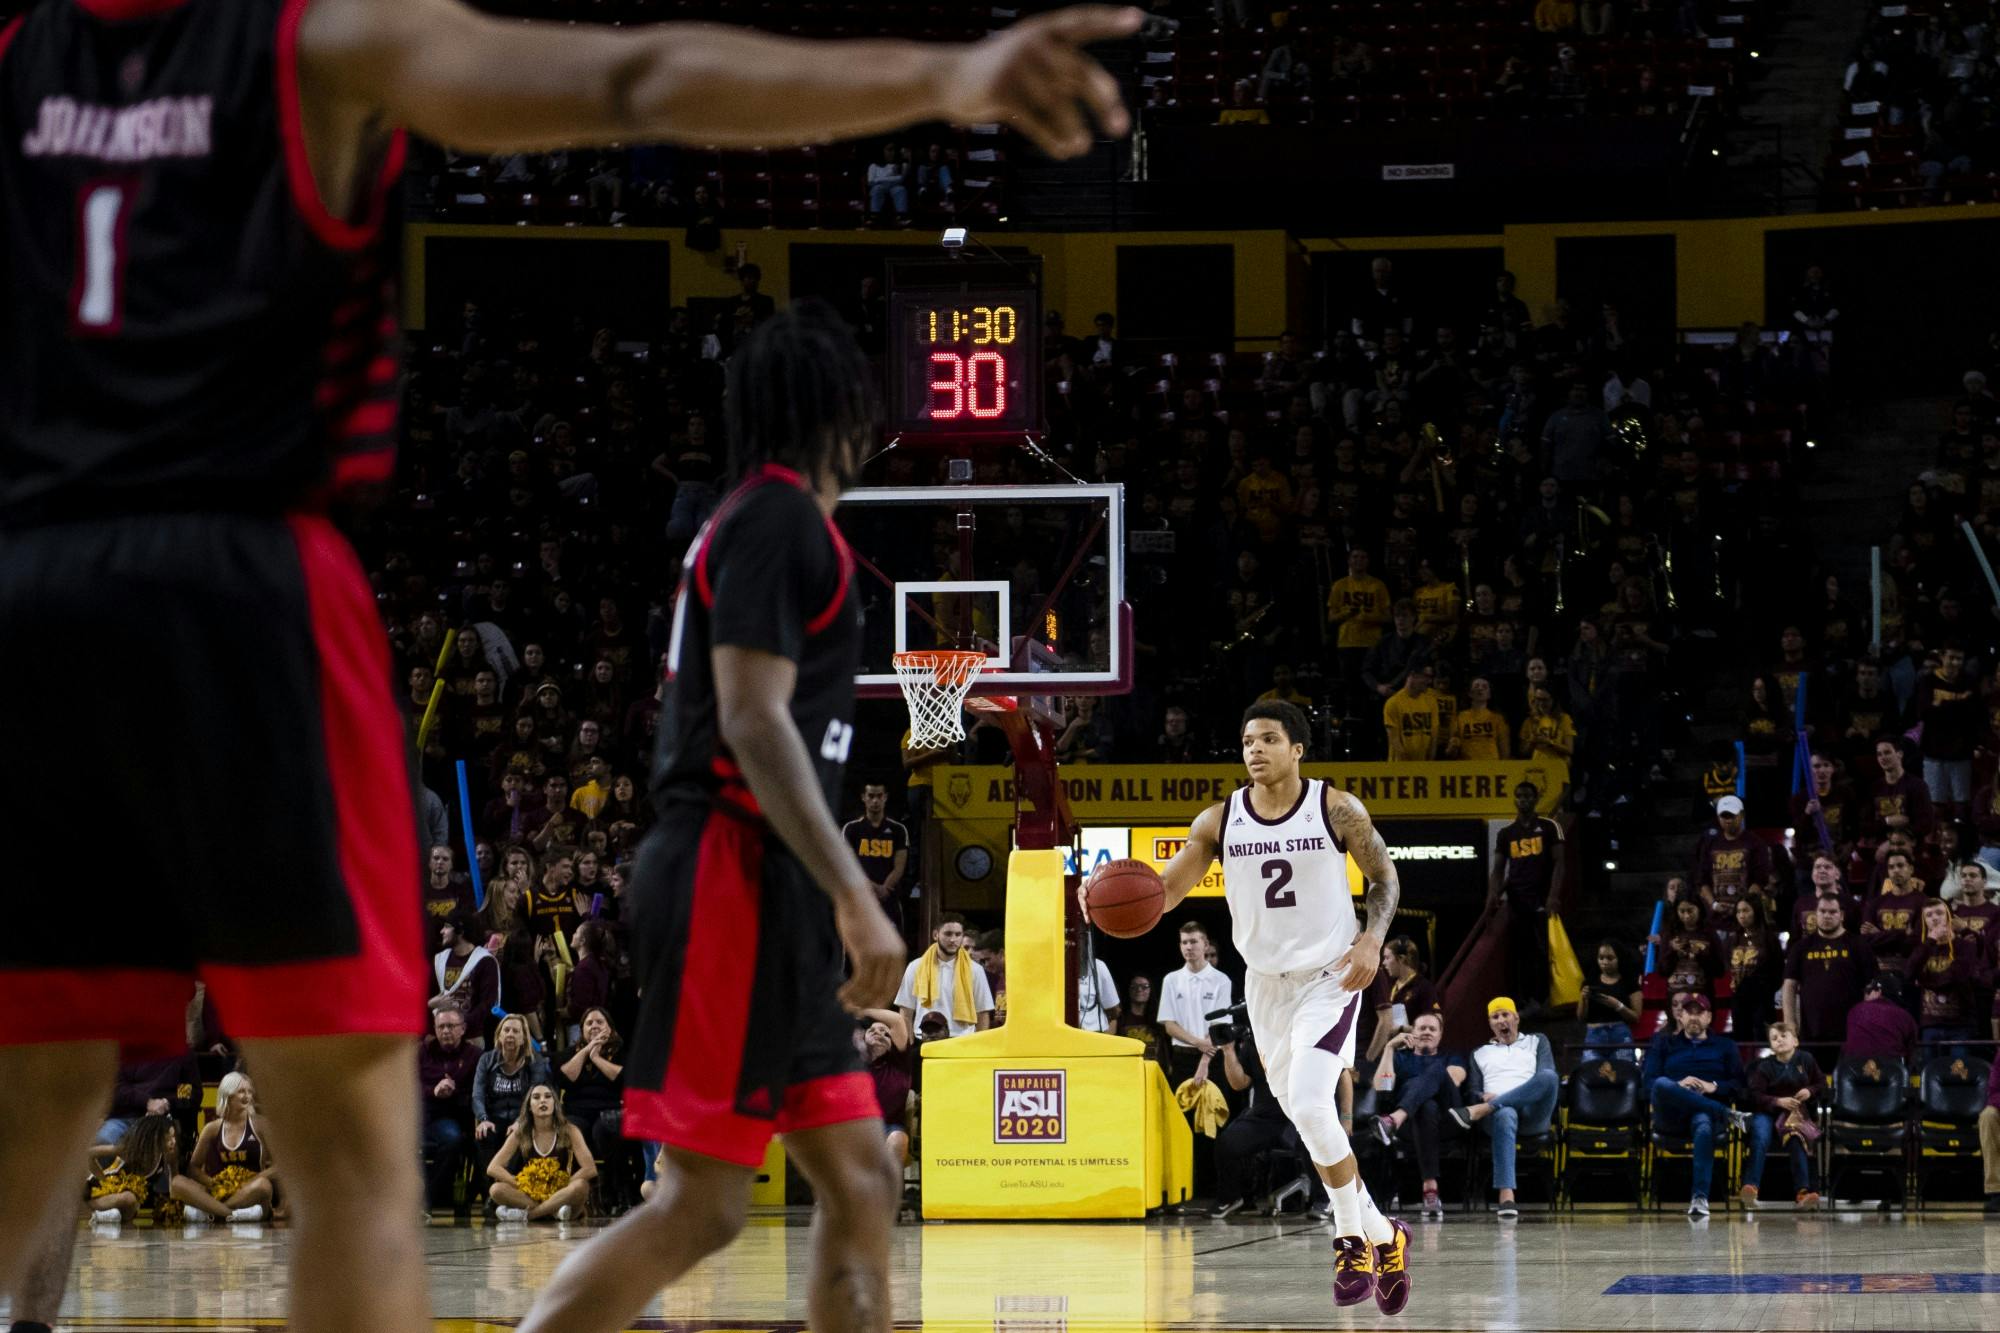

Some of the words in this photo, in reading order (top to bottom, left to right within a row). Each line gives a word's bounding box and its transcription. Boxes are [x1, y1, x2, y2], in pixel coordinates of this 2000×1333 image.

[23, 96, 211, 162] JOHNSON
[78, 184, 123, 326] 1
[930, 307, 1016, 343] 11:30
[930, 352, 1005, 418] 30
[1343, 591, 1376, 606] ASU
[1403, 712, 1431, 730] ASU
[1463, 722, 1493, 737] ASU
[987, 779, 1102, 801] ABON
[1111, 779, 1152, 801] ALL
[1162, 778, 1224, 801] HOPE
[1345, 776, 1429, 799] ENTER
[1439, 775, 1507, 798] HERE
[859, 838, 893, 857] ASU
[1229, 841, 1281, 857] ARIZONA
[1286, 837, 1325, 852] STATE
[1386, 846, 1475, 860] OWERADE
[1510, 836, 1542, 857] ASU
[1261, 859, 1296, 908] 2
[1003, 1078, 1058, 1089] CAMPAIGN
[1001, 1090, 1059, 1117] ASU
[1001, 1119, 1060, 1136] 2020
[936, 1158, 989, 1168] TOGETHER,
[991, 1158, 1012, 1167] OUR
[1014, 1158, 1065, 1167] POTENTIAL
[1067, 1158, 1078, 1166] IS
[1079, 1157, 1130, 1166] LIMITLESS
